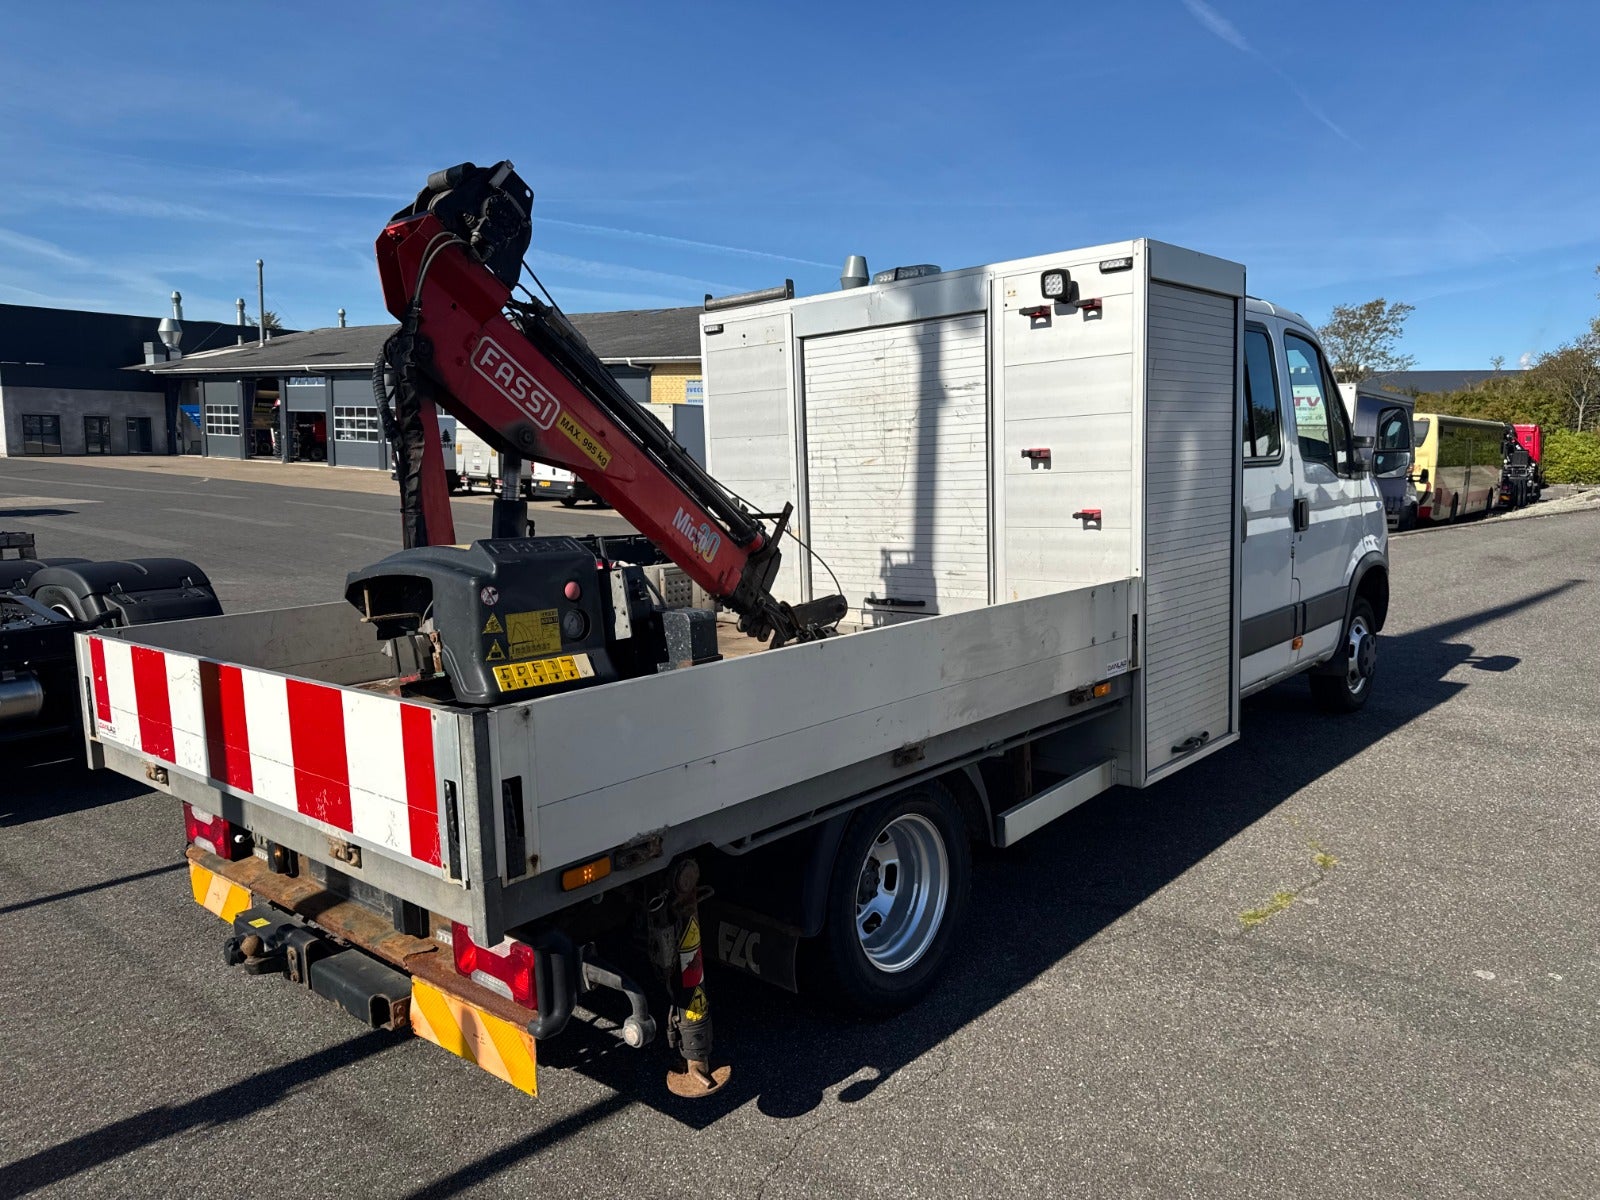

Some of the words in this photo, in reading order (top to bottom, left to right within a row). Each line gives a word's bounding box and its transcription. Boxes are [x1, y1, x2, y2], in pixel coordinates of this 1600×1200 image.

[479, 347, 552, 421] FASSI
[560, 417, 582, 442] MAX.
[583, 438, 598, 455] 995
[597, 452, 609, 467] kg
